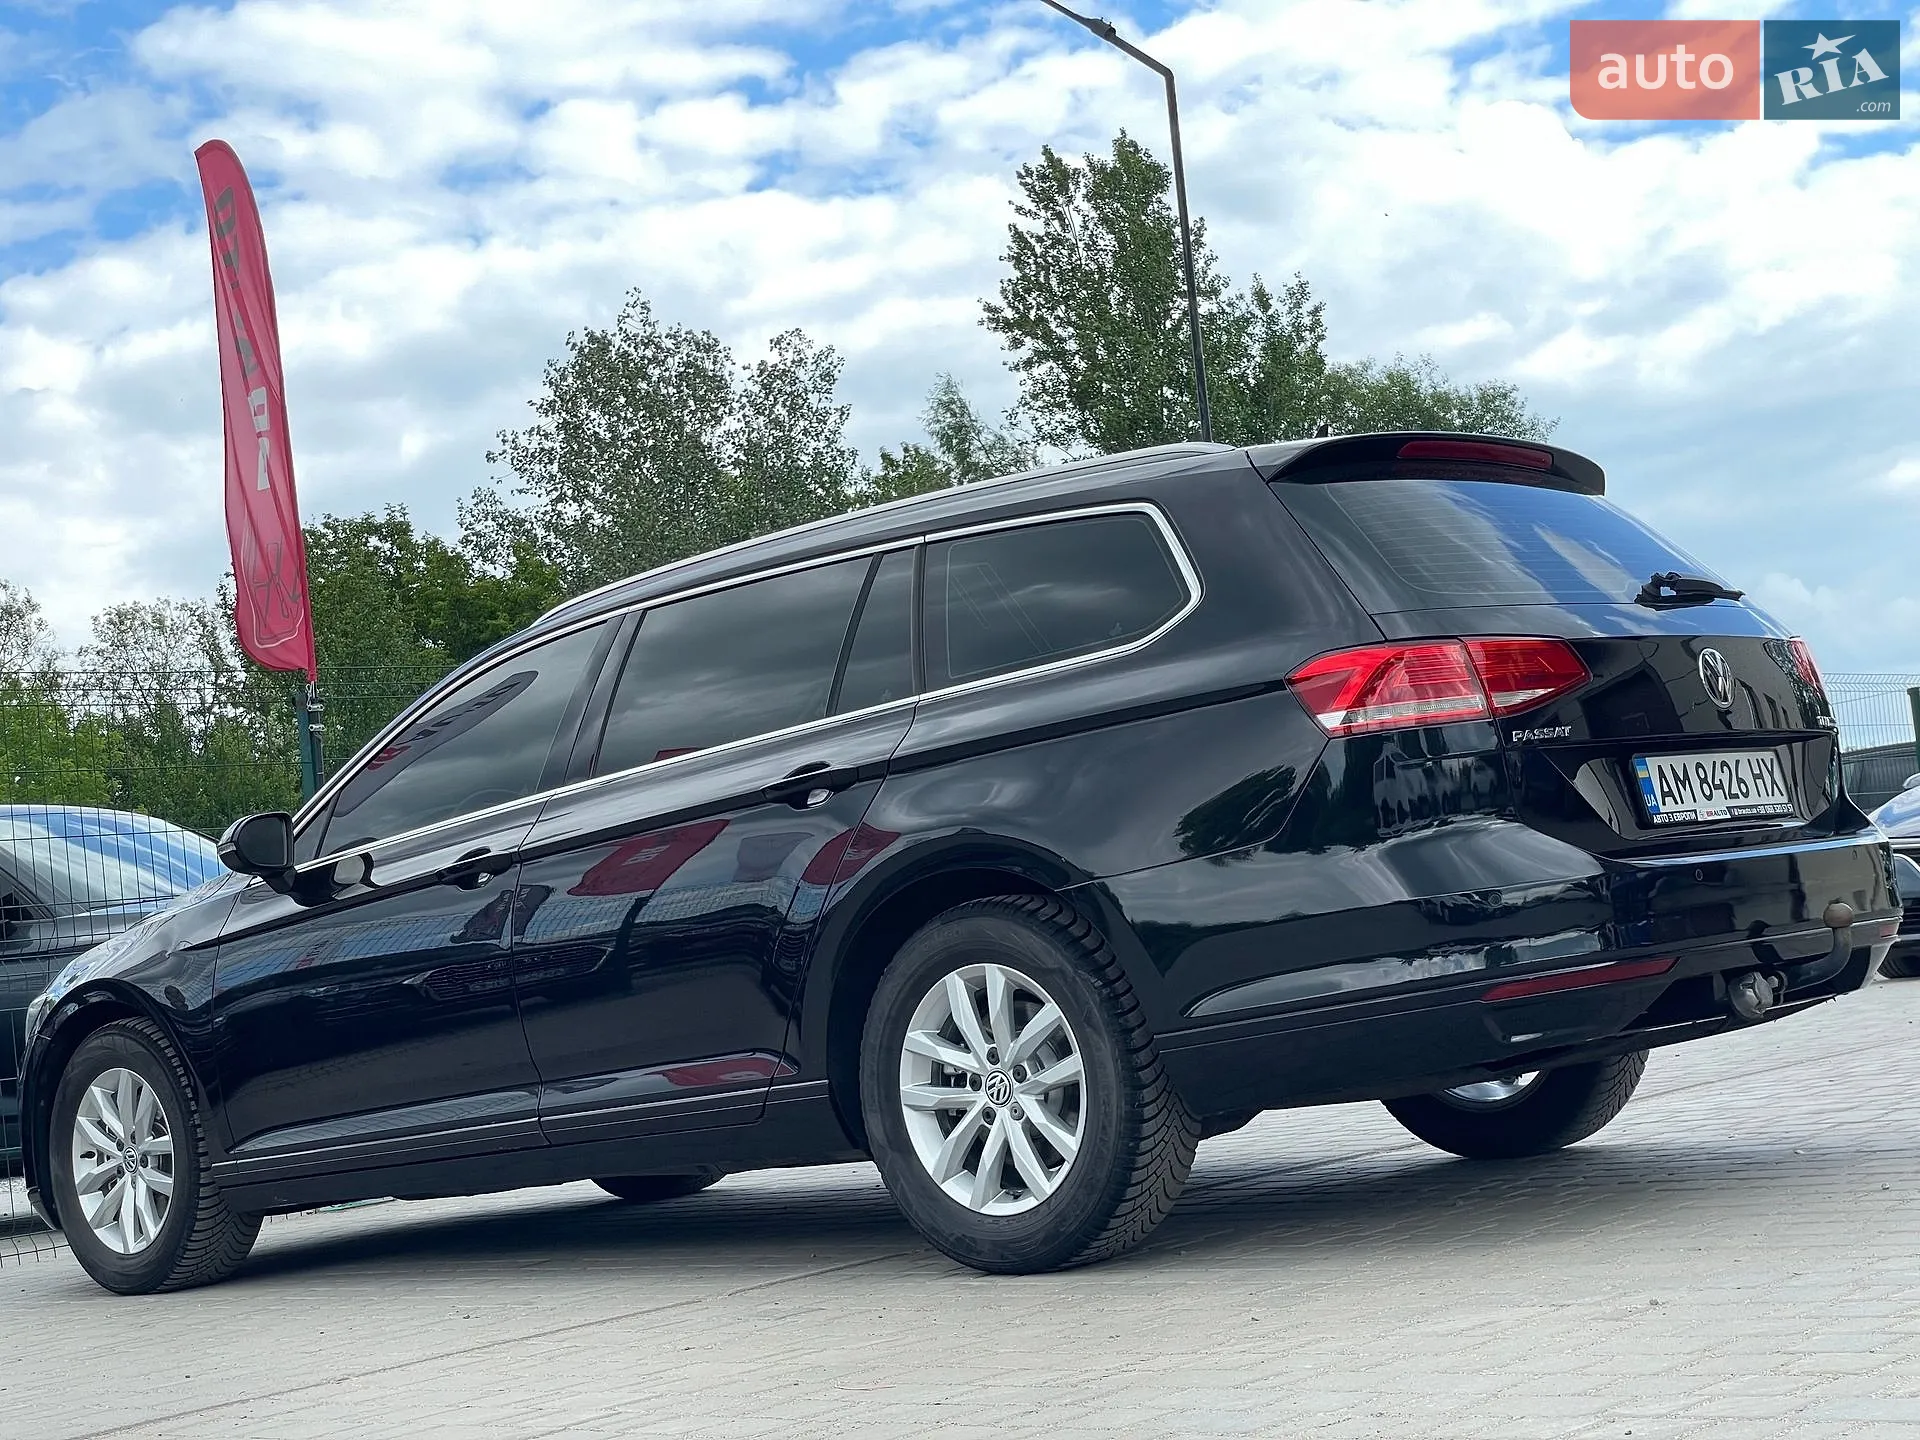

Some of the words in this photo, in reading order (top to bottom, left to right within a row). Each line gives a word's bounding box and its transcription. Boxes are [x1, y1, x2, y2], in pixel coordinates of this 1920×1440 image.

[1512, 725, 1572, 742] PASSAT
[1657, 763, 1697, 806] AM
[1695, 759, 1750, 802] 8426
[1747, 758, 1784, 798] HX
[1644, 794, 1657, 807] UA
